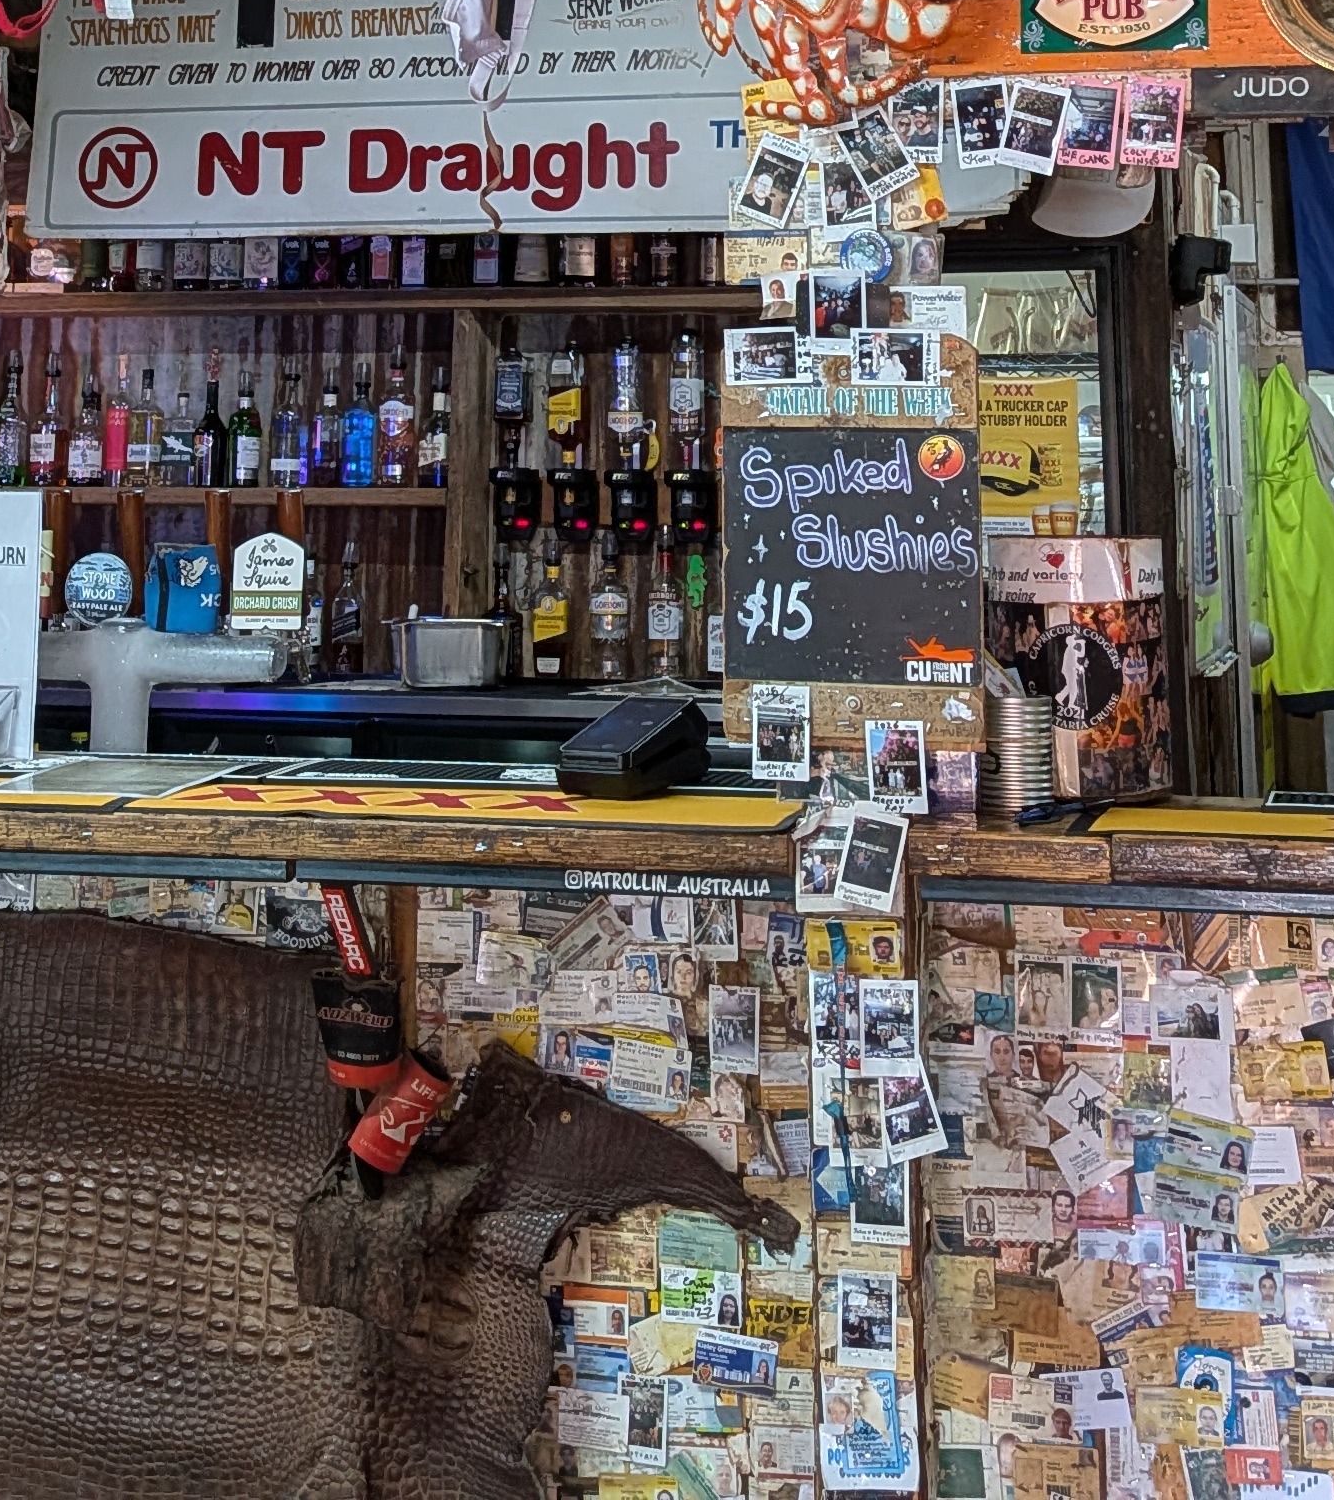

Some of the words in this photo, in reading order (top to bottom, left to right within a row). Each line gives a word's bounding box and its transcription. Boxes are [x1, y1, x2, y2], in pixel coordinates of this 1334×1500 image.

[1120, 22, 1151, 34] 1930
[97, 65, 160, 87] CREDIT
[168, 63, 219, 85] GIVEN
[226, 62, 247, 83] TO
[253, 60, 315, 83] WOMEN
[321, 59, 360, 81] OVER
[368, 58, 395, 79] 80
[540, 52, 563, 73] BY
[572, 52, 617, 72] THEIR
[1233, 74, 1312, 101] JUDO
[197, 130, 325, 197] NT
[348, 121, 680, 212] Draught
[834, 387, 858, 416] OF
[862, 387, 898, 416] THE
[994, 384, 1034, 397] XXXX
[995, 401, 1044, 412] TRUCKER
[1046, 400, 1068, 412] CAP
[979, 415, 1022, 427] STUBBY
[1024, 414, 1067, 427] HOLDER
[740, 438, 913, 513] Spiked
[791, 513, 979, 576] Slushies
[246, 545, 295, 570] James
[82, 571, 117, 584] STONE
[244, 565, 292, 588] Squire
[80, 587, 116, 601] WOOD
[234, 595, 271, 610] ORCHARD
[272, 595, 298, 610] CRUSH
[738, 578, 814, 644] $15
[1028, 624, 1079, 660] CAPRICORN
[1082, 626, 1121, 670] CODGERS
[1056, 705, 1085, 720] 2021
[1089, 692, 1120, 728] CRUISE
[326, 893, 365, 972] REDARC
[410, 1078, 436, 1101] LIFE
